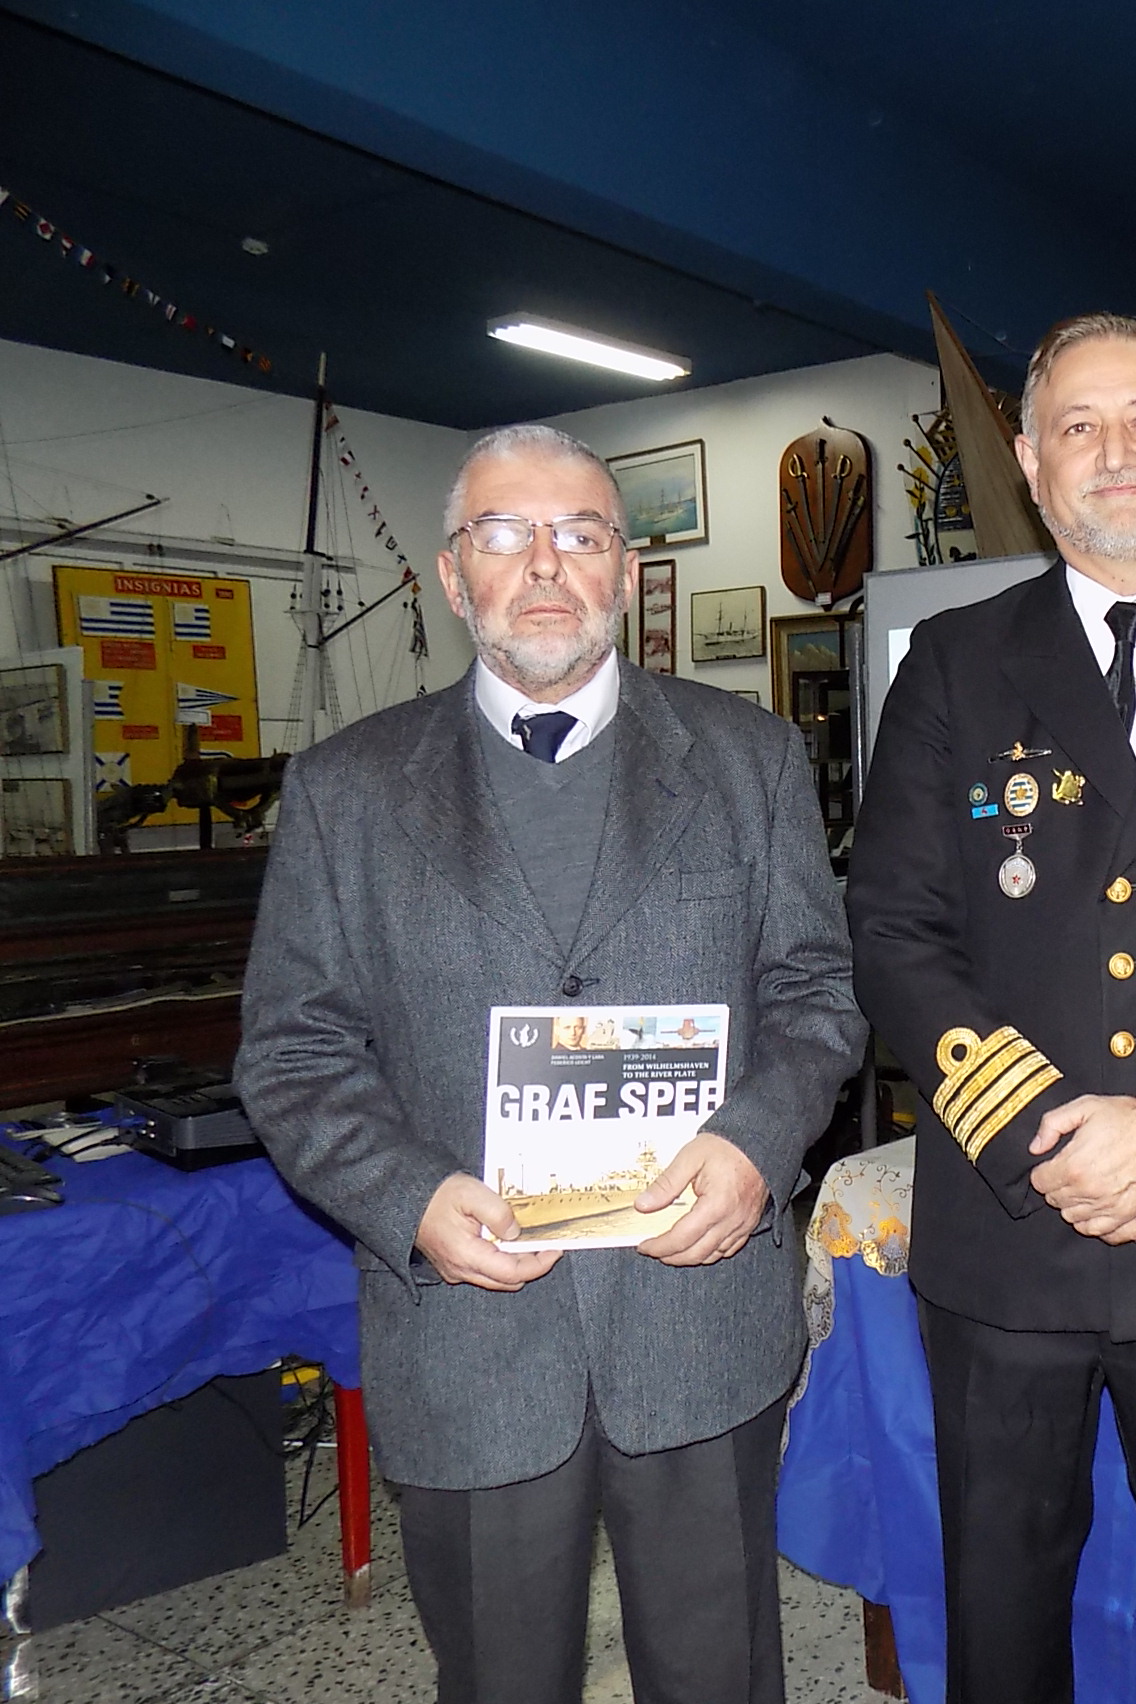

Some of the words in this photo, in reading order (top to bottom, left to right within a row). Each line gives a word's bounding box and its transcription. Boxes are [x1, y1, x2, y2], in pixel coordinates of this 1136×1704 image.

[116, 578, 201, 595] INSIGNIAS
[622, 1063, 645, 1071] FROM
[646, 1062, 709, 1070] WILHELMSHAVEN
[674, 1070, 696, 1078] PLATE
[498, 1083, 608, 1122] GRAF
